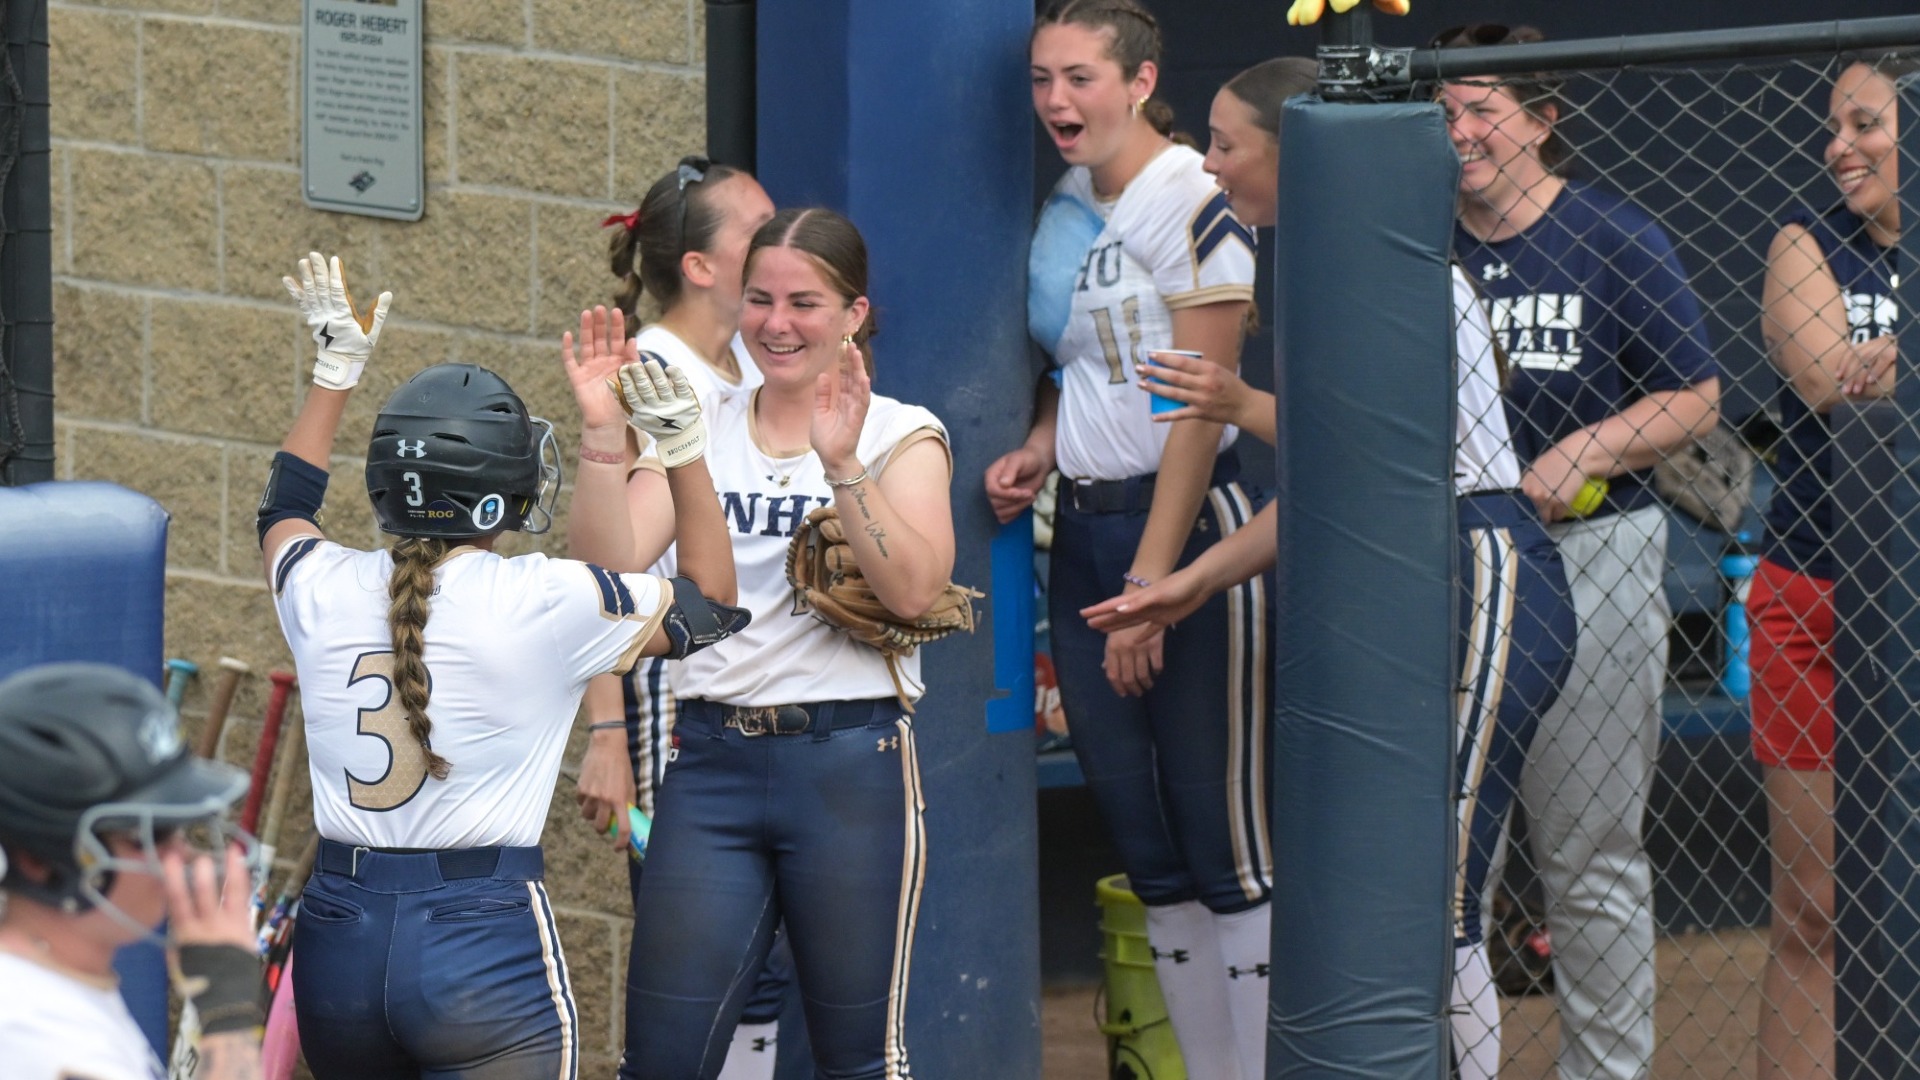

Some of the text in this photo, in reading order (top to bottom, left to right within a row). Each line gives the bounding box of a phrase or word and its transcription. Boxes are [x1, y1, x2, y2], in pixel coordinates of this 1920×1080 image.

[315, 8, 408, 34] ROGER HEBERT
[402, 471, 424, 507] 3
[427, 510, 455, 519] ROG
[716, 491, 832, 538] NH
[343, 650, 434, 813] 3
